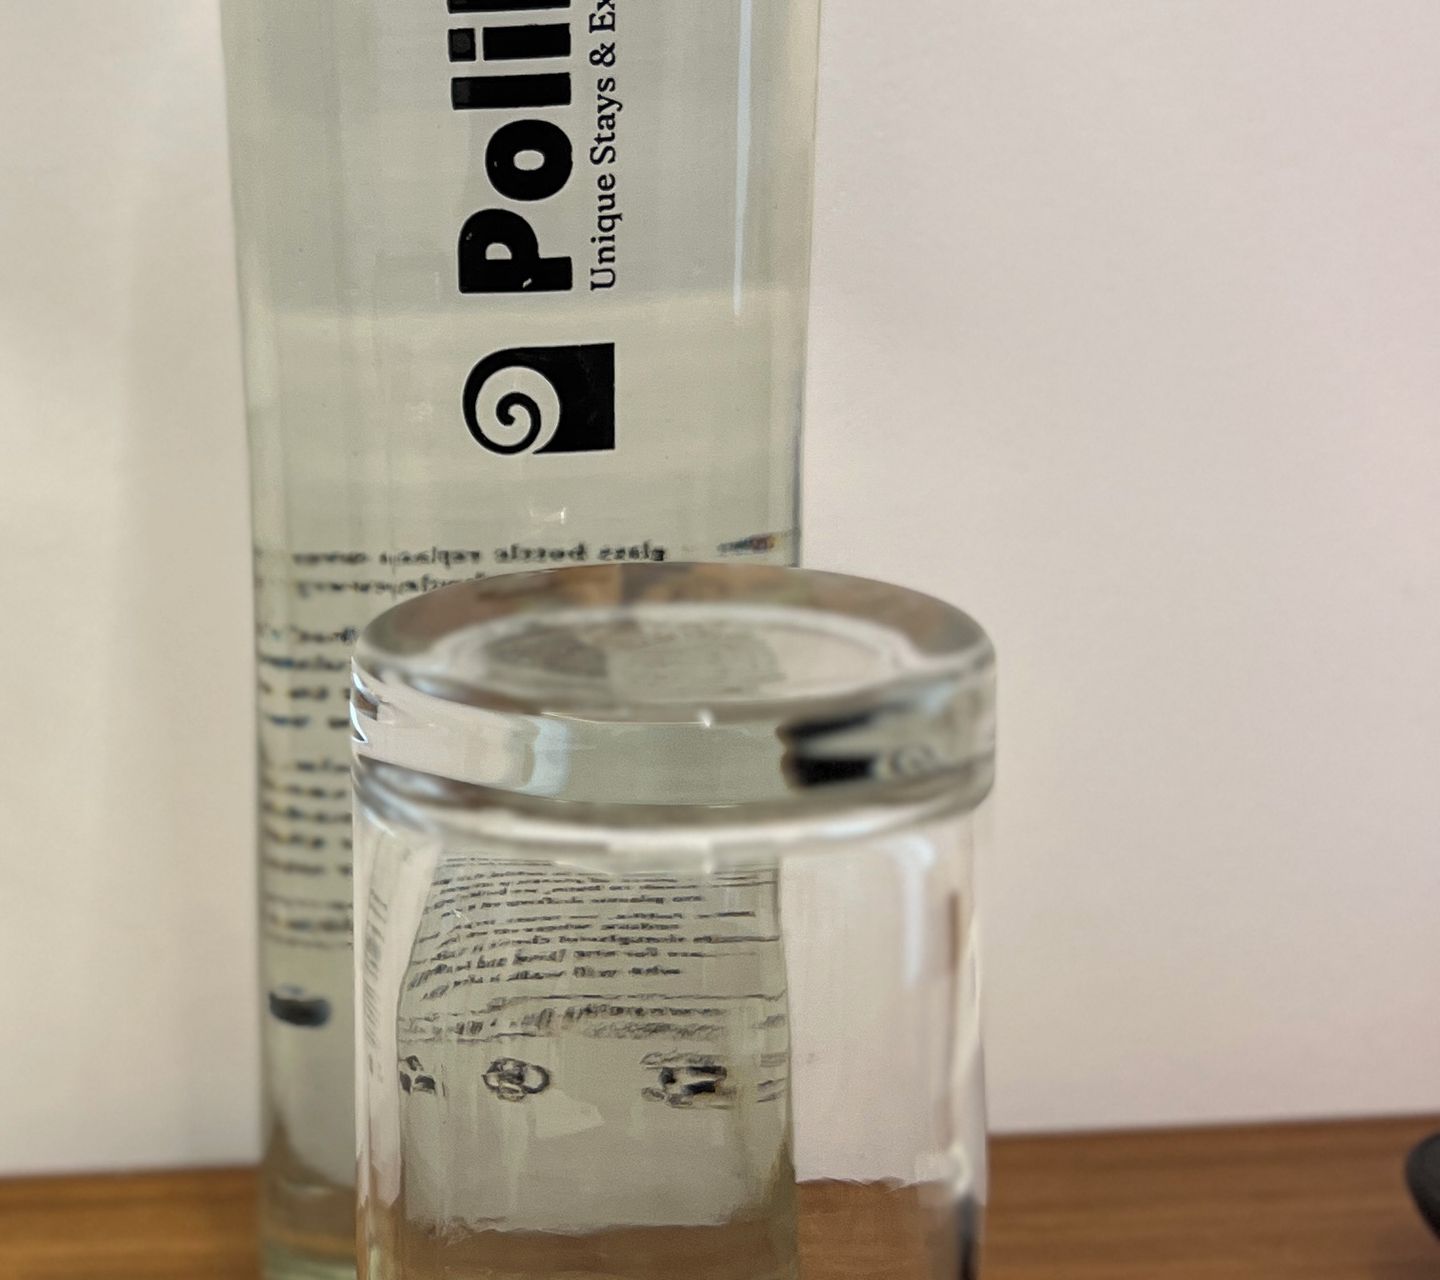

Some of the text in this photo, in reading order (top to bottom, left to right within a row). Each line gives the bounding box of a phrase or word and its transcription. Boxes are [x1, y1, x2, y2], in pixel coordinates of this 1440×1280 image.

[588, 42, 616, 68] &
[589, 77, 624, 166] Stays
[590, 173, 623, 291] Unique
